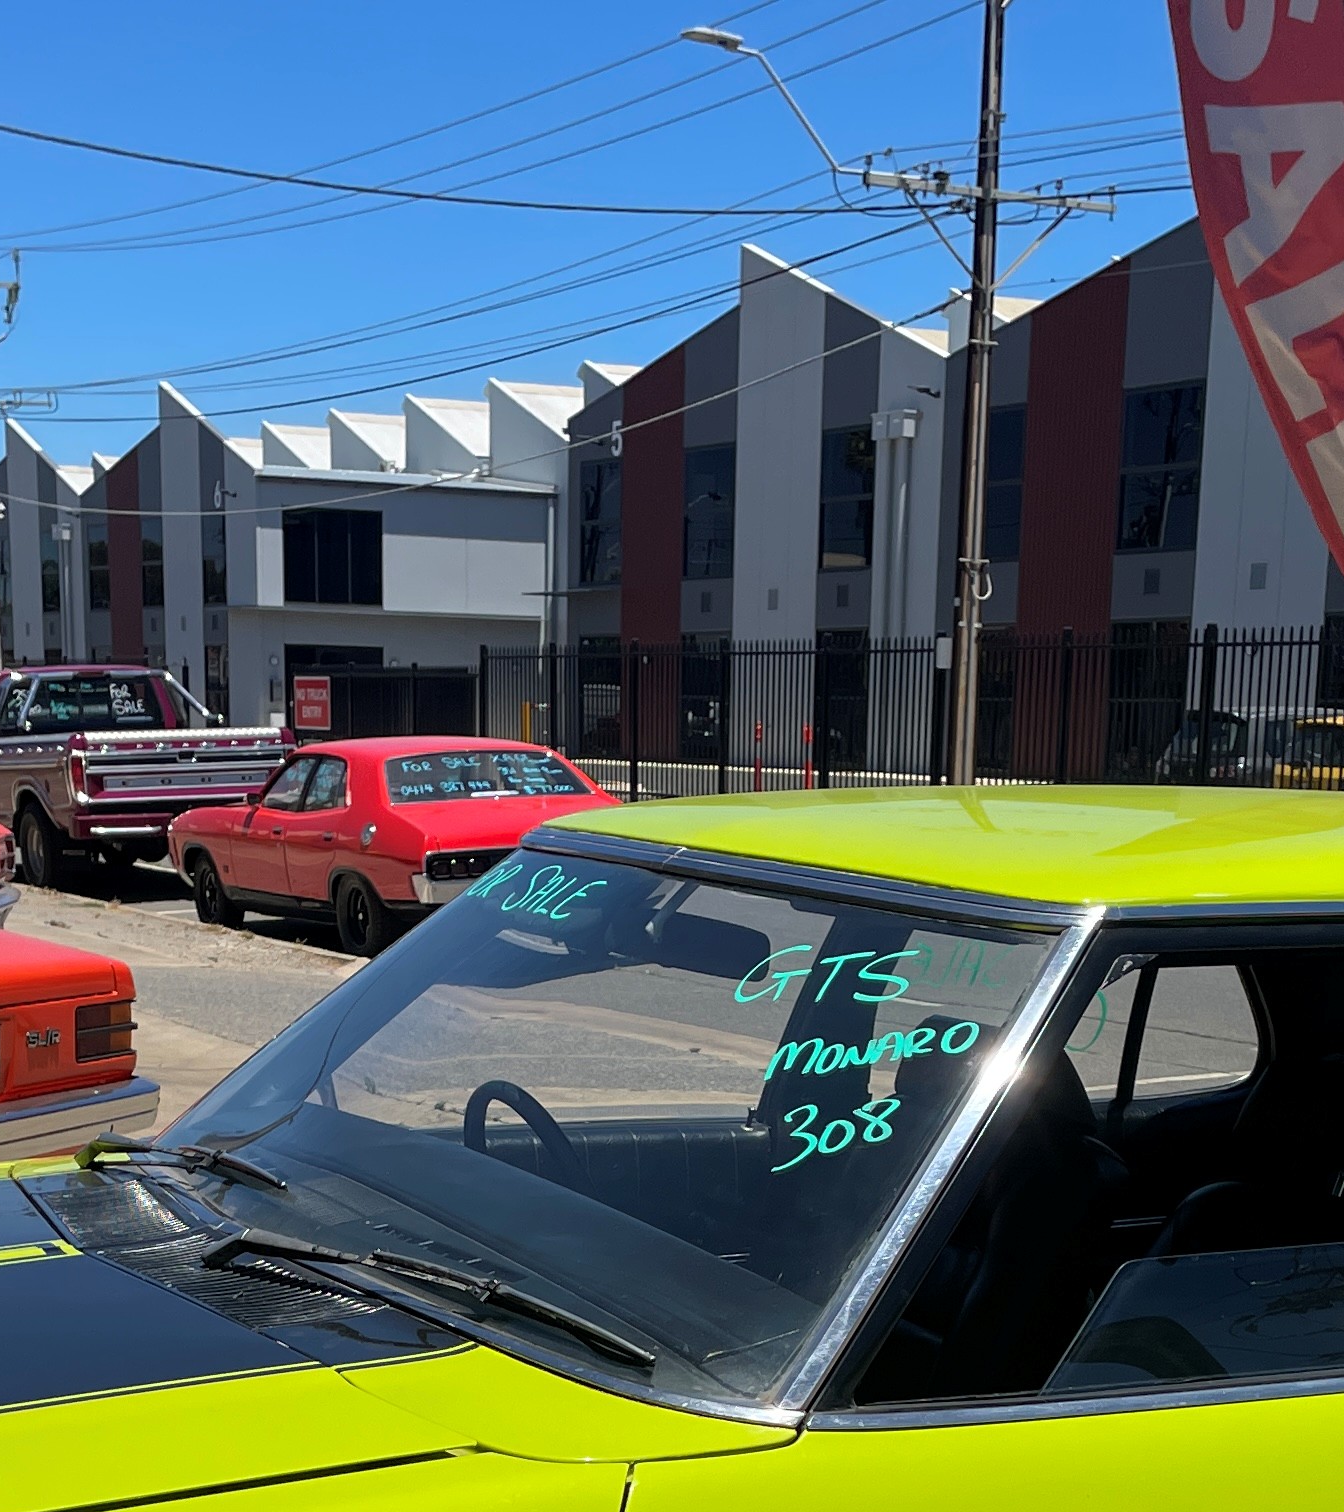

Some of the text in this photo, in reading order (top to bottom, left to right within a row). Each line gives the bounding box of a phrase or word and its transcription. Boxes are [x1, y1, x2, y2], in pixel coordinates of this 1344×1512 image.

[611, 420, 623, 457] 5
[109, 683, 131, 699] FOR
[111, 699, 146, 715] SALE
[401, 761, 433, 773] FOR
[441, 756, 481, 769] SALE
[501, 865, 608, 919] SALE
[734, 944, 921, 1004] GTS
[763, 1021, 980, 1082] MONARO
[770, 1099, 902, 1173] 308
